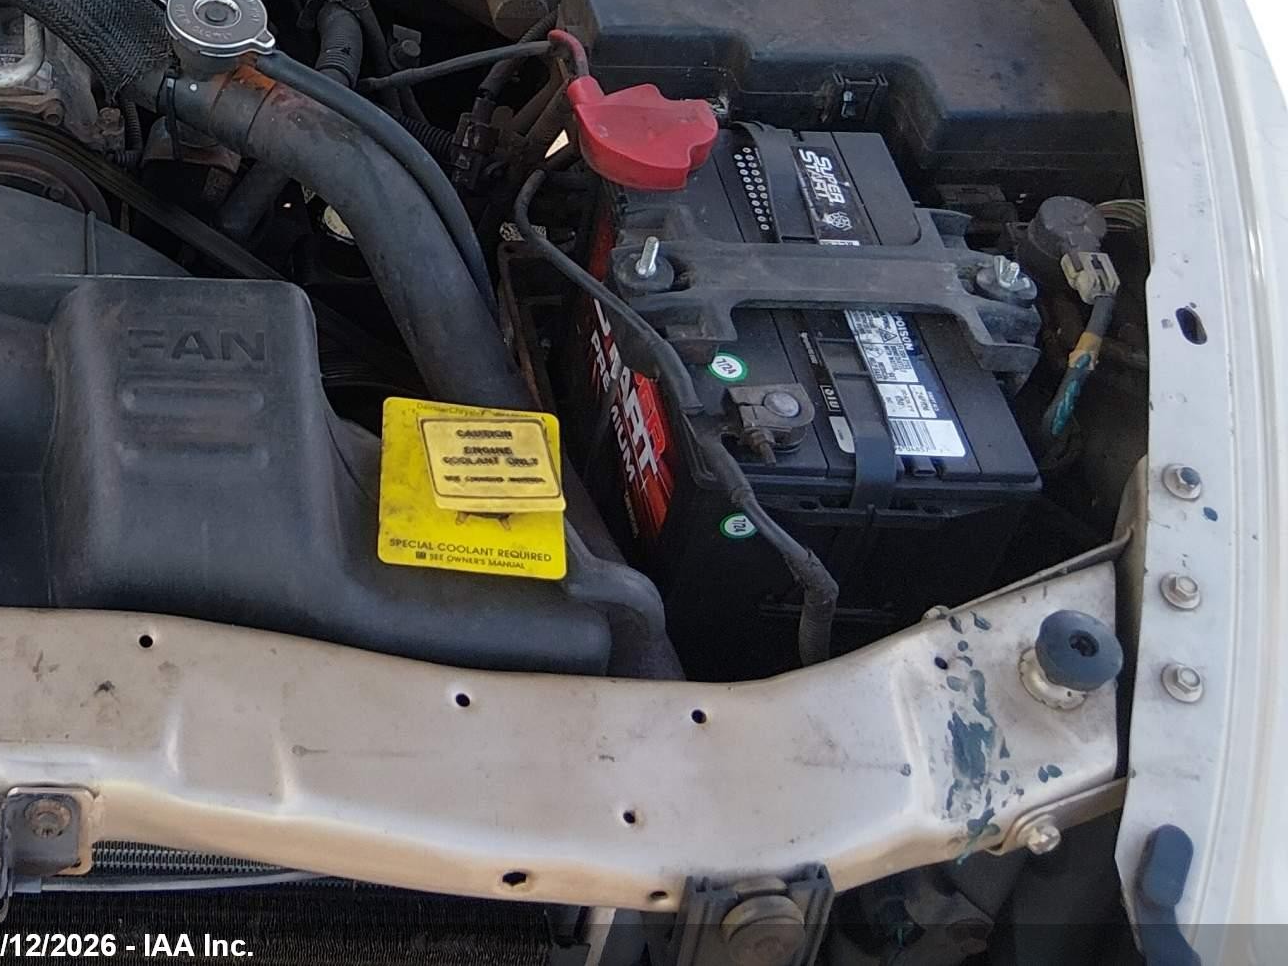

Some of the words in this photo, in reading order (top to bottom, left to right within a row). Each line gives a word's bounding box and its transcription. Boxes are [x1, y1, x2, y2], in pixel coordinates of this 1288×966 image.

[798, 148, 830, 199] START
[816, 156, 846, 204] SUPER
[893, 315, 915, 352] POISON
[127, 327, 266, 361] FAN
[716, 358, 738, 376] 7/24
[455, 429, 513, 440] CAUTION
[463, 446, 514, 456] ENGINE
[442, 456, 499, 466] COOLANT
[734, 518, 747, 533] 7/24
[389, 537, 434, 551] SPECIAL
[437, 542, 494, 557] COOLANT
[497, 548, 552, 562] REQUIRED
[429, 553, 444, 561] SEE
[446, 555, 486, 566] OWNER'S
[487, 559, 526, 570] MANUAL
